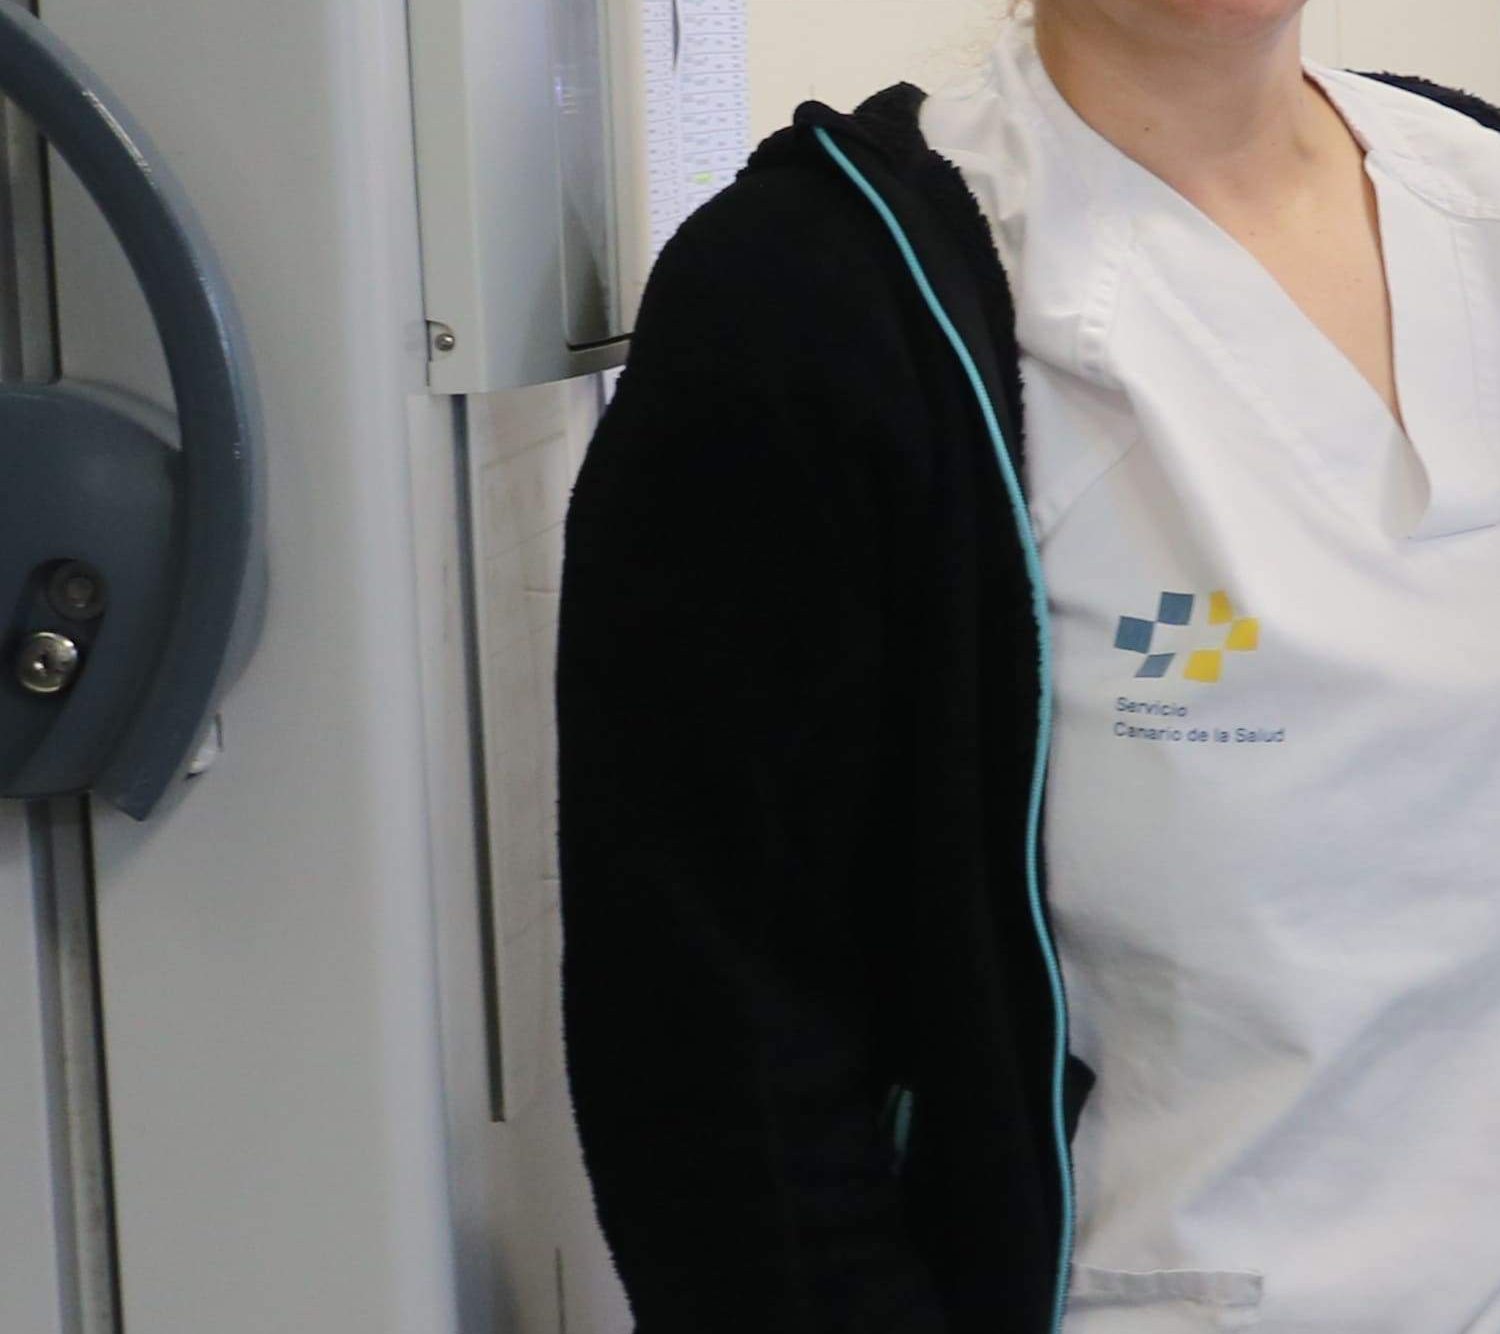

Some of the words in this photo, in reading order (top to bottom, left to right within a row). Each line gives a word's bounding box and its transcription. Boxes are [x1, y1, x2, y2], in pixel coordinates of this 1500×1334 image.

[1115, 696, 1188, 718] Servicio
[1113, 721, 1182, 742] Canario
[1186, 726, 1209, 743] de
[1213, 726, 1229, 743] la
[1234, 727, 1286, 744] Salud
